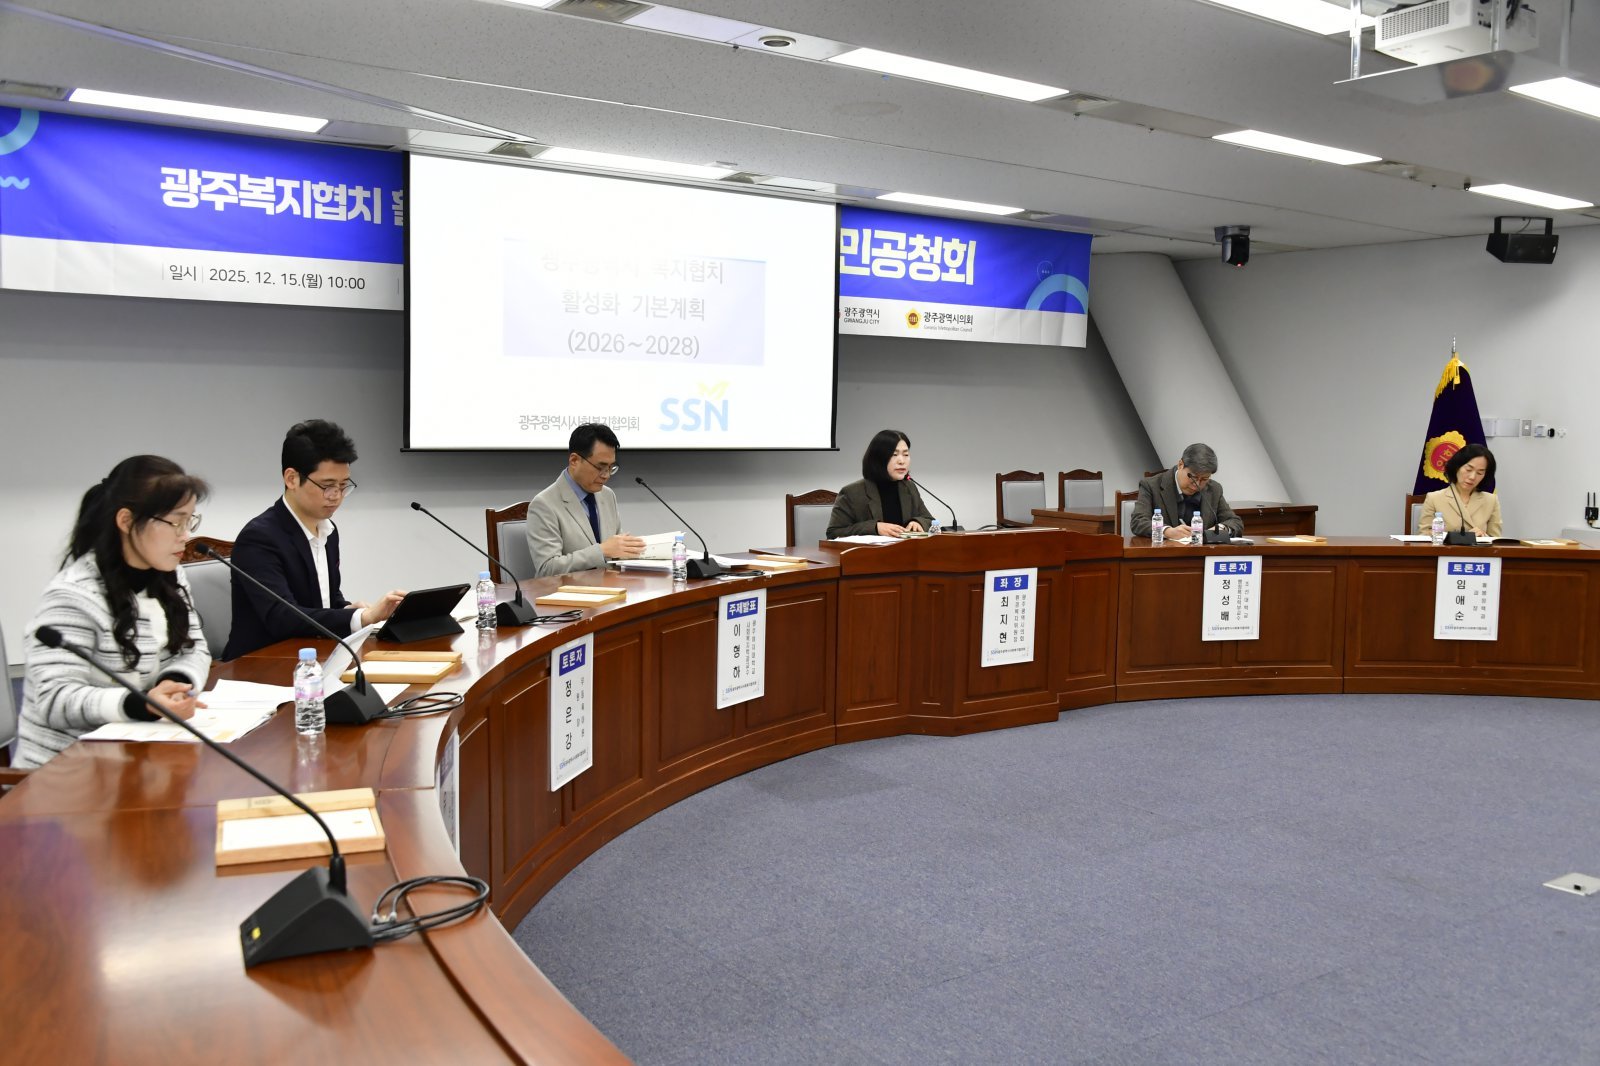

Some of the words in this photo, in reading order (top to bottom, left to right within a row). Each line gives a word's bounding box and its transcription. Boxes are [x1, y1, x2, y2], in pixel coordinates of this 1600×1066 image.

[160, 166, 382, 225] 광주복지협치
[168, 264, 197, 281] 일시
[208, 268, 250, 284] 2025.
[255, 271, 276, 286] 12.
[328, 275, 366, 290] 10:00
[562, 289, 621, 316] 활성화
[632, 295, 706, 322] 기본계획
[844, 307, 880, 319] 광주광역시
[923, 312, 974, 325] 광주광역시의회
[567, 330, 700, 359] (2026~2028)
[658, 397, 729, 433] SSN
[1218, 562, 1248, 573] 토론자
[1452, 563, 1486, 574] 토론자
[728, 600, 757, 616] 주제발표
[1220, 579, 1231, 621] 정성배
[1455, 579, 1466, 621] 임애순
[999, 595, 1009, 644] 최지현
[562, 647, 583, 669] 토론자
